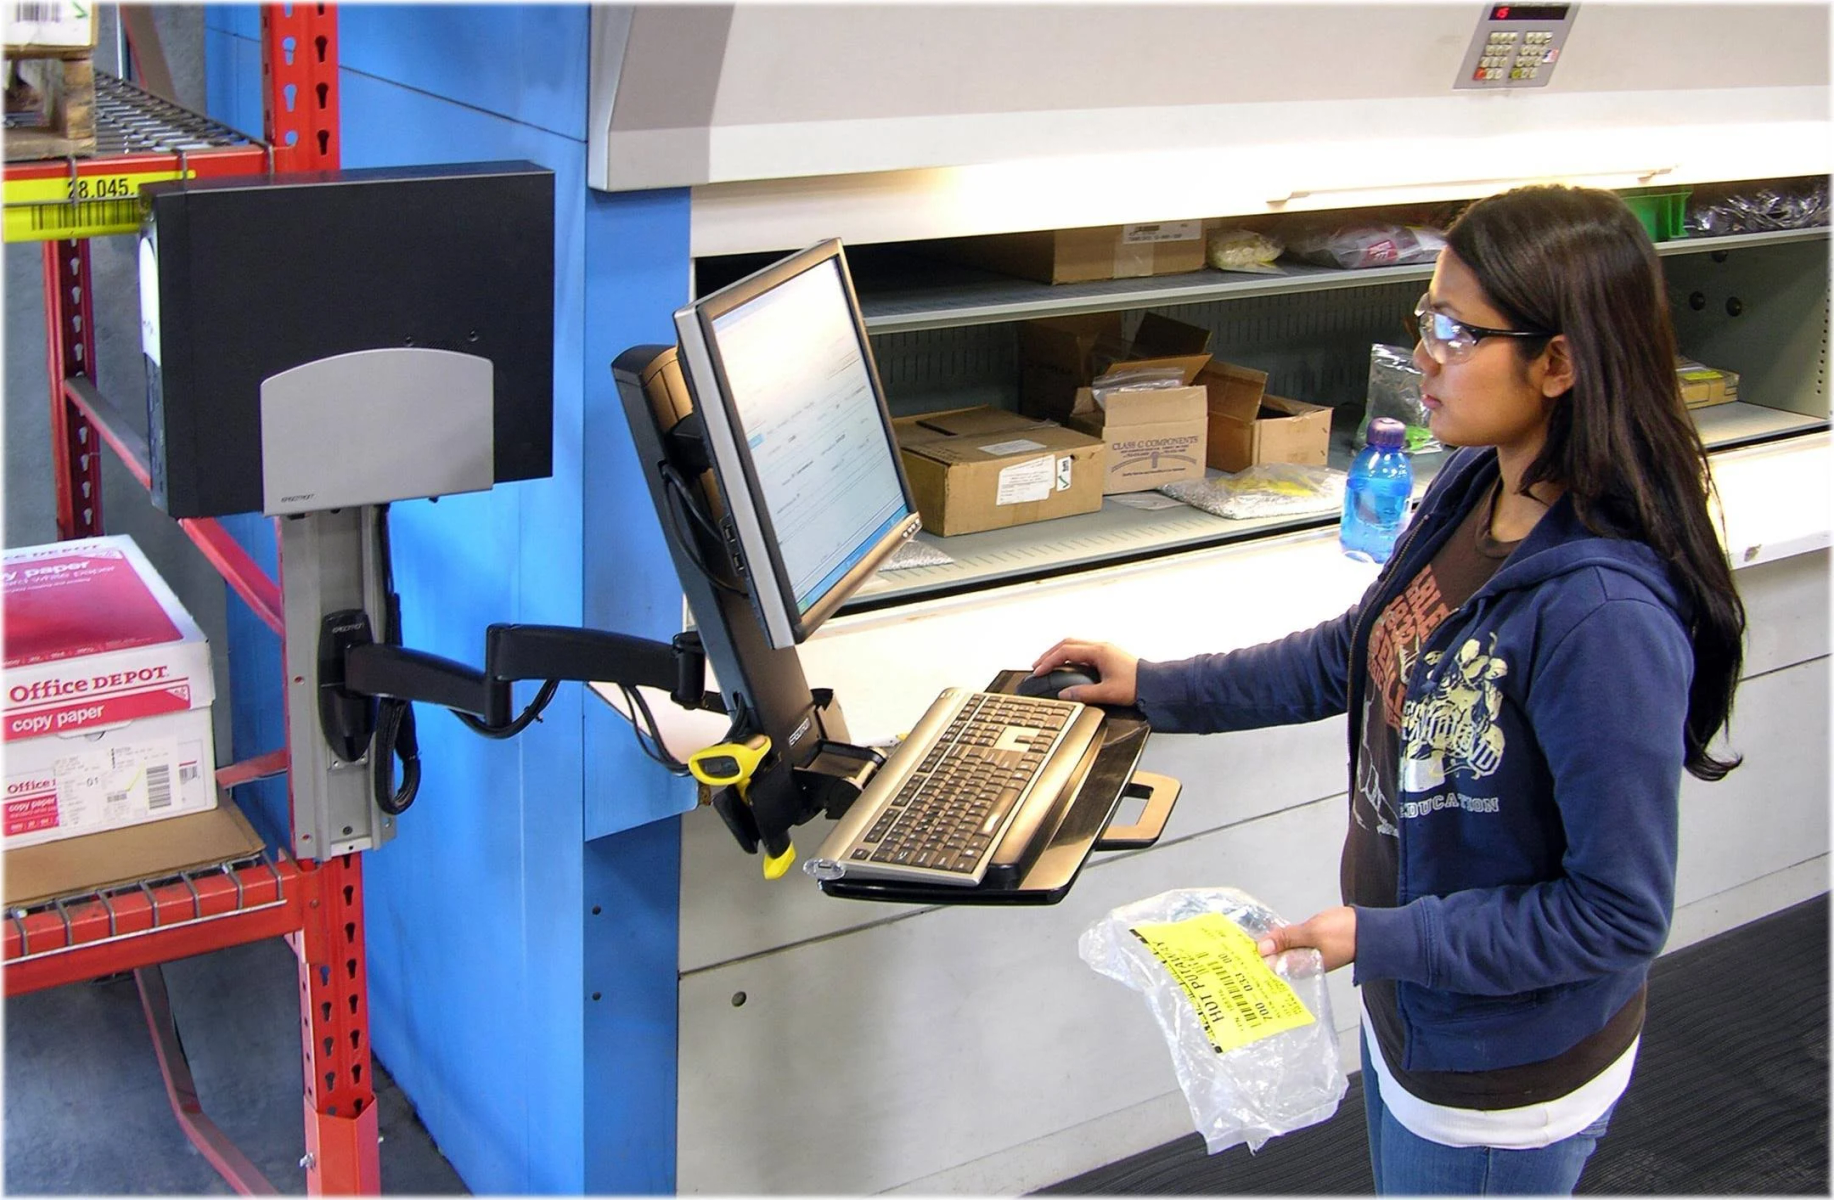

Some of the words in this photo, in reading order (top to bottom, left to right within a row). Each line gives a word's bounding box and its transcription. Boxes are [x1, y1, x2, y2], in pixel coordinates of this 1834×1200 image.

[1112, 442, 1136, 451] CLASS
[1145, 435, 1199, 447] COMPONENTS
[9, 678, 88, 702] Office
[93, 665, 168, 690] DEPOT
[12, 713, 52, 733] copy
[57, 705, 104, 728] paper
[8, 779, 50, 794] Office
